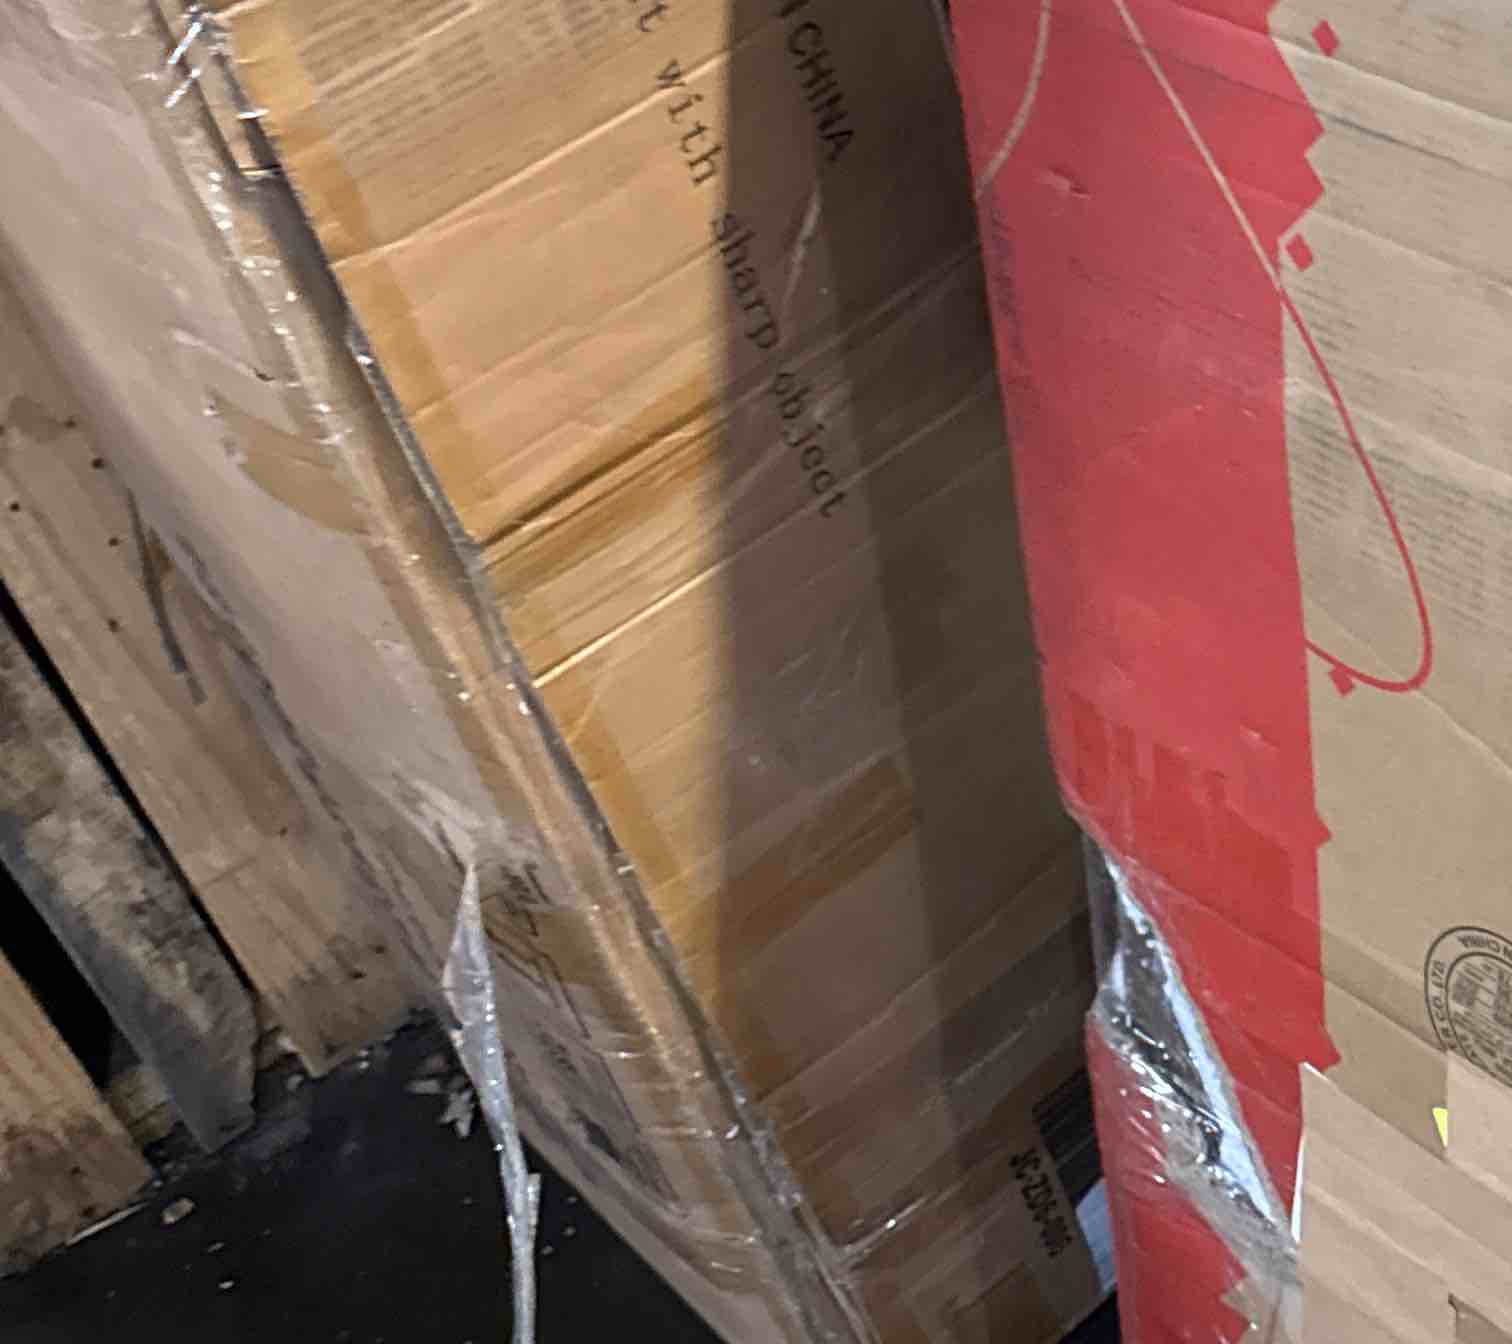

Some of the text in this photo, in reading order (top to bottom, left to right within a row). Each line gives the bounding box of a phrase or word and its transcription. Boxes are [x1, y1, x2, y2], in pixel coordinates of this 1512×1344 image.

[783, 17, 858, 164] CHINA
[654, 59, 722, 187] with
[709, 213, 781, 355] sharp
[771, 364, 850, 521] object
